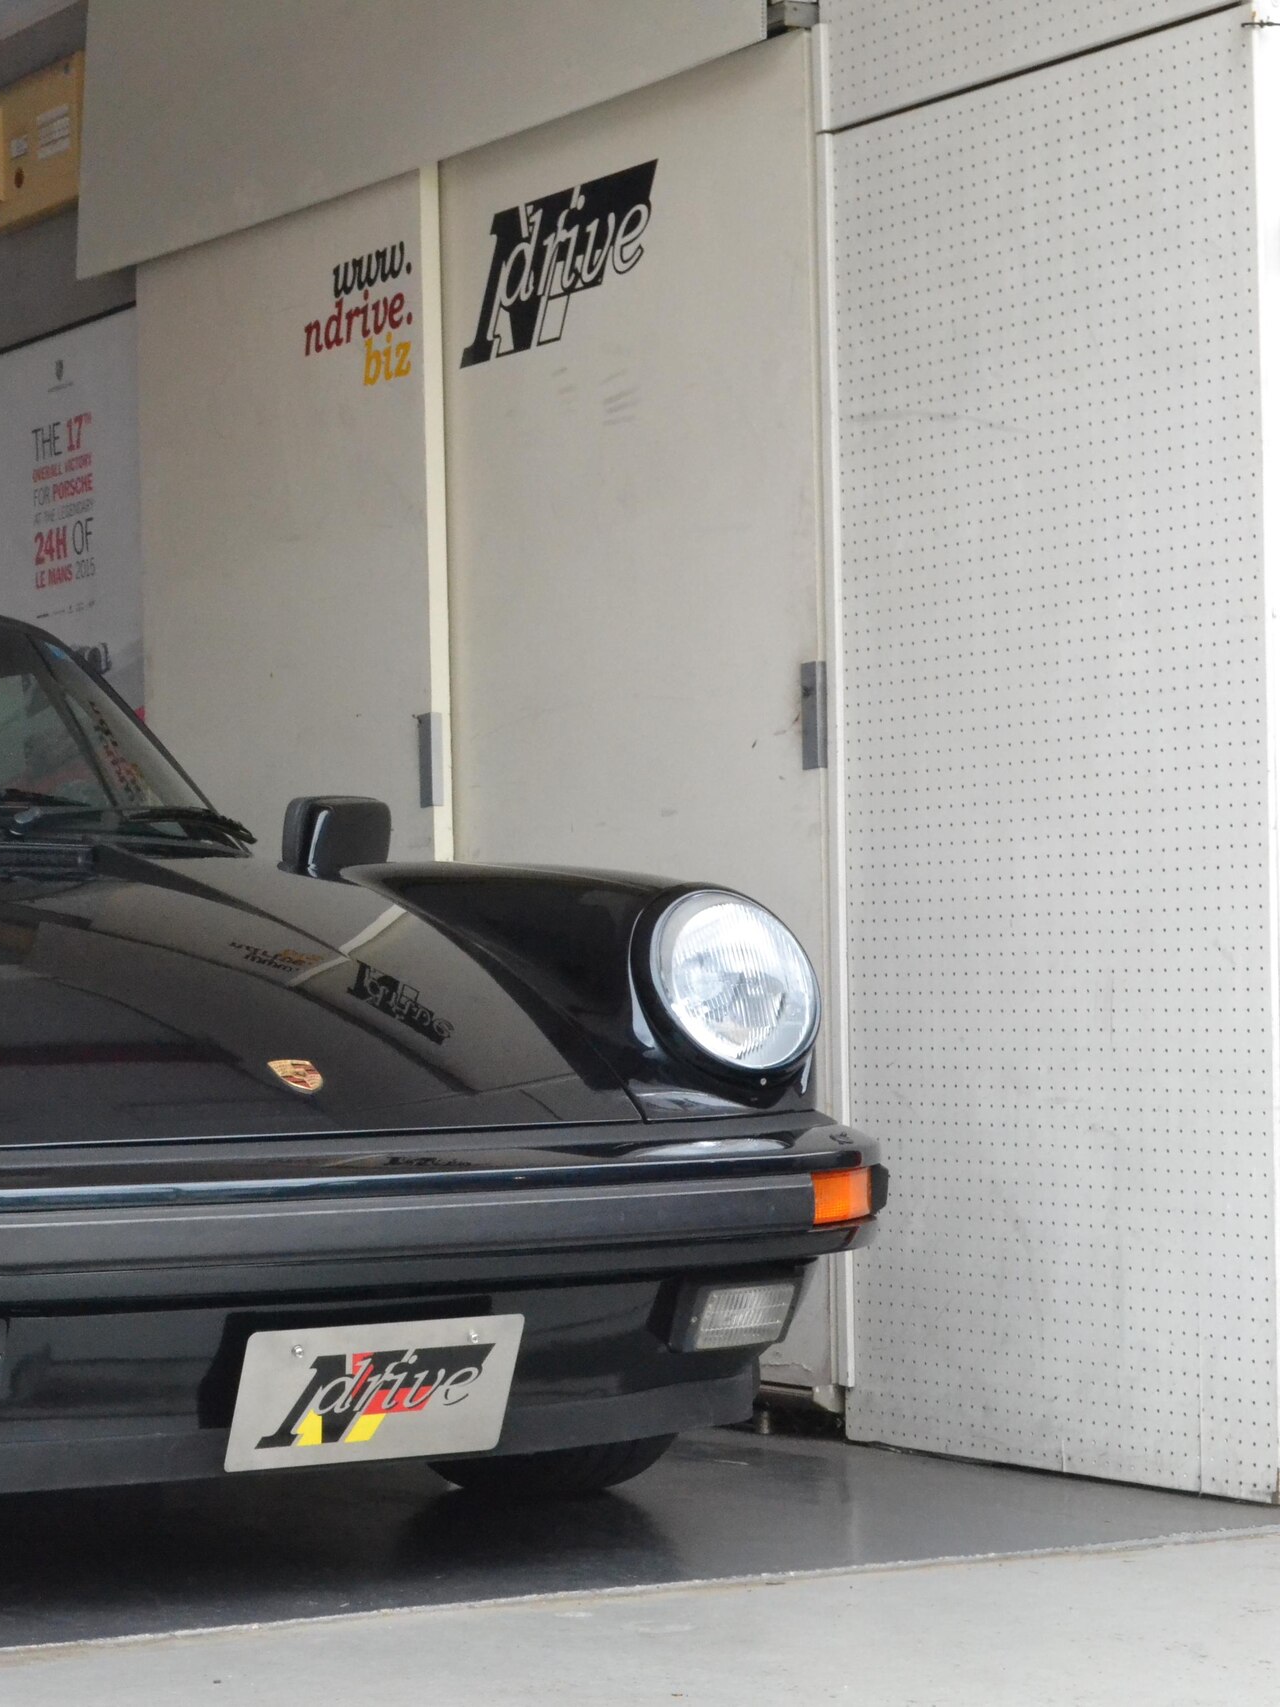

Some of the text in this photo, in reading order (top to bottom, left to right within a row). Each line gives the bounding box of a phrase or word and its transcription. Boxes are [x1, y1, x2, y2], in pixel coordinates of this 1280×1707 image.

[332, 240, 412, 298] www.
[304, 289, 413, 356] ndrive.
[363, 334, 412, 386] biz
[31, 422, 63, 461] THE
[33, 474, 94, 507] FOR PORSCHE
[34, 517, 94, 566] 24H OF
[35, 557, 96, 590] LE MANS 2015
